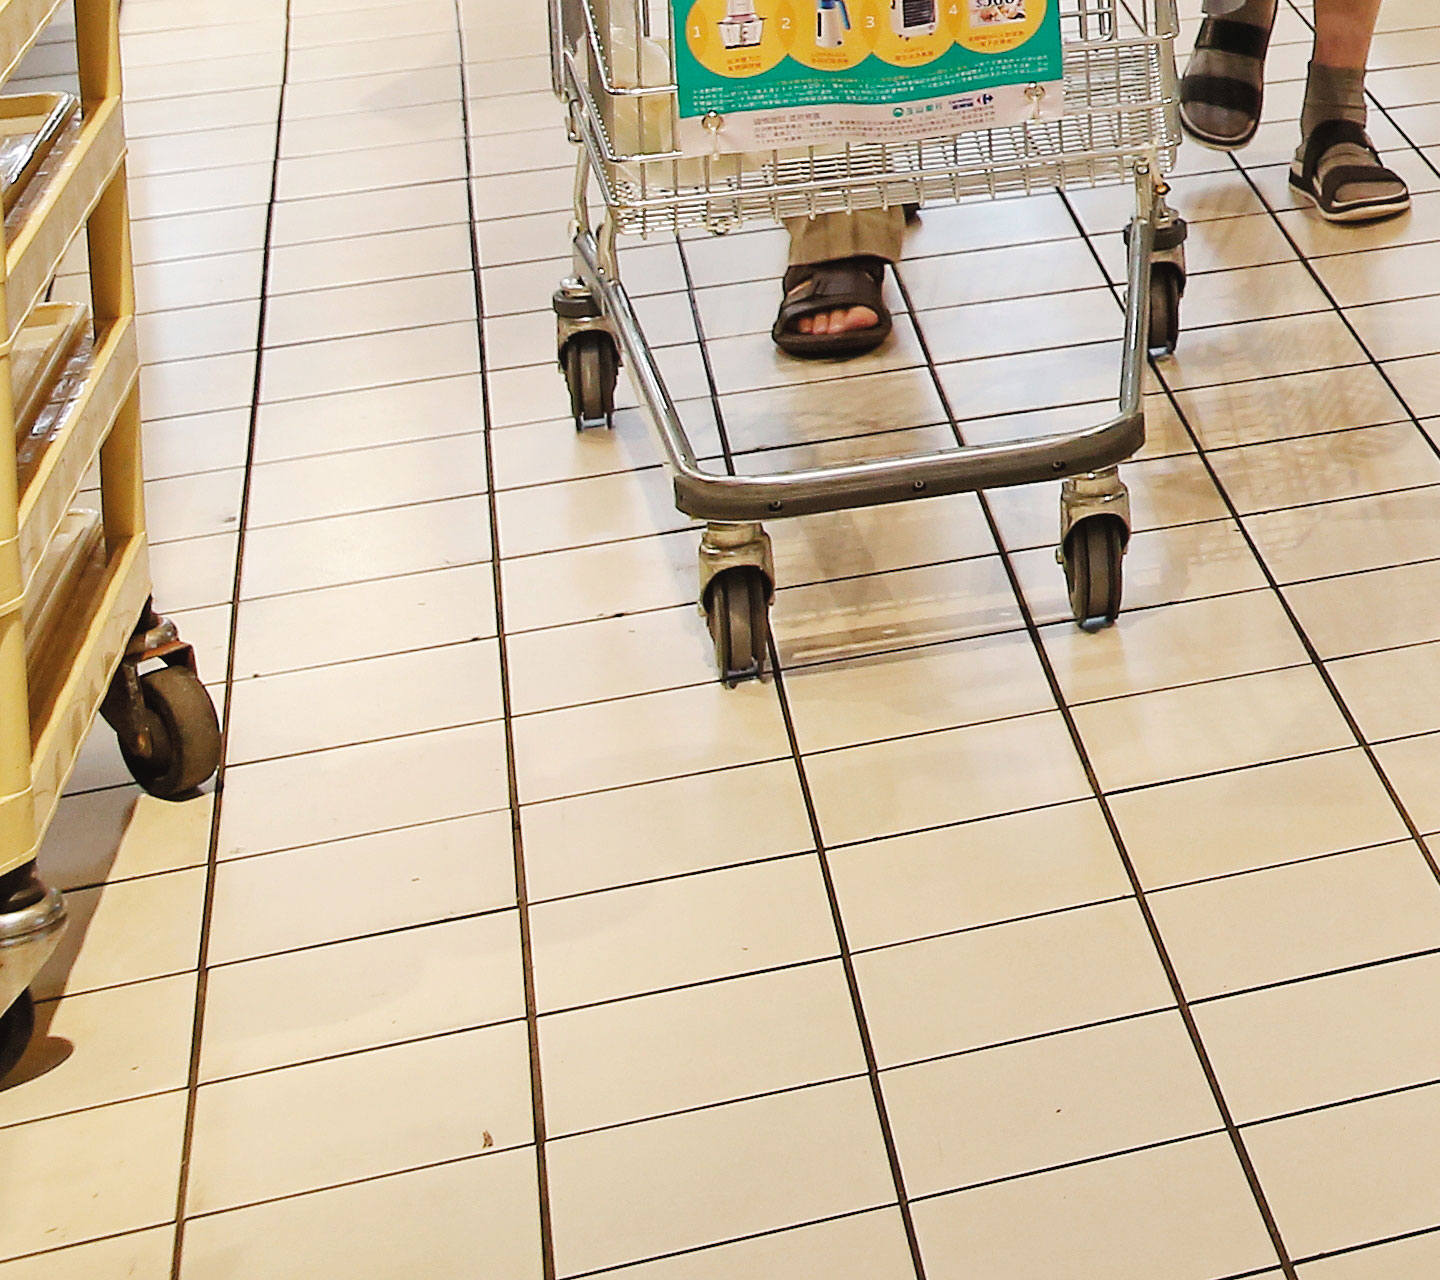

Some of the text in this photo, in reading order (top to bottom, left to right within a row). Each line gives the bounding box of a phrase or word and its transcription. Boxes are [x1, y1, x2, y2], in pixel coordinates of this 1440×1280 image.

[781, 17, 791, 30] 2
[866, 16, 876, 29] 3
[948, 3, 958, 16] 4
